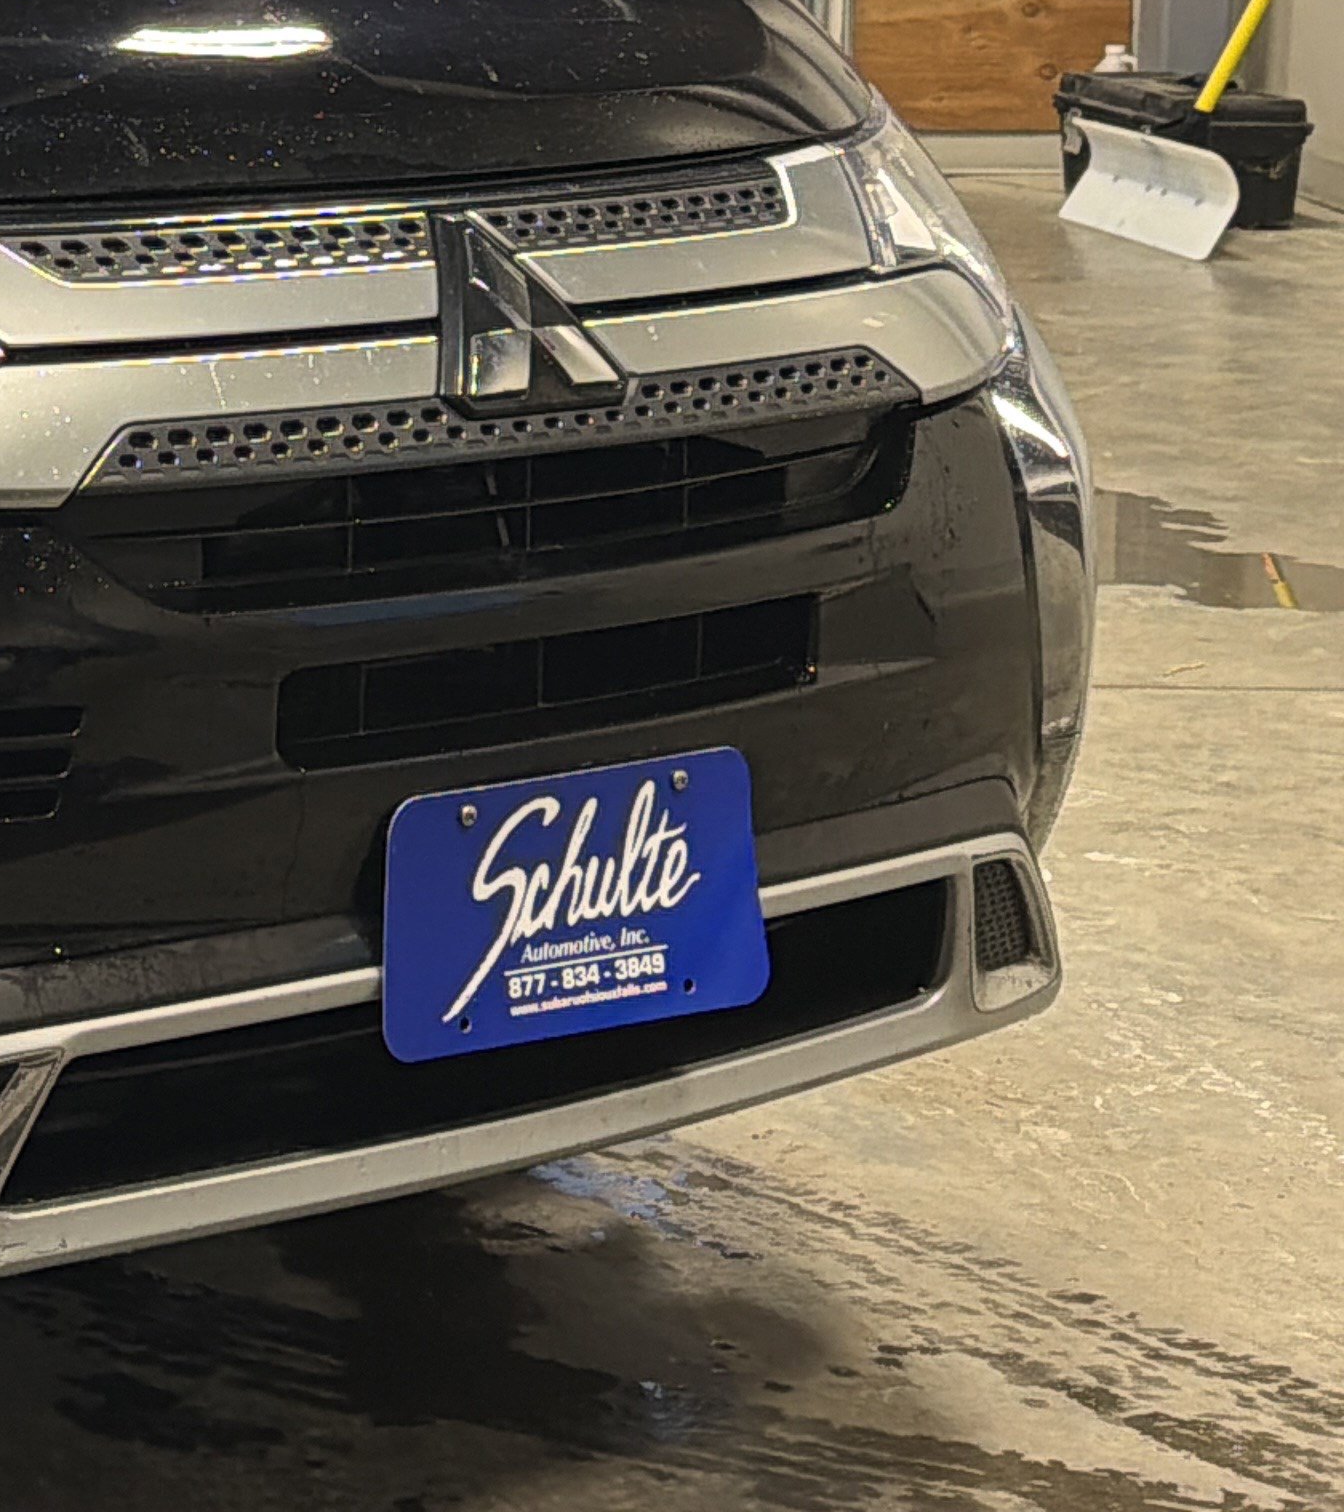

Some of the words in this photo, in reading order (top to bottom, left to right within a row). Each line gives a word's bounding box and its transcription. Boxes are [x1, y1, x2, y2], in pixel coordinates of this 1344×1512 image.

[442, 779, 700, 1023] Schulte
[520, 931, 616, 964] Automotive,
[620, 927, 650, 947] Inc.
